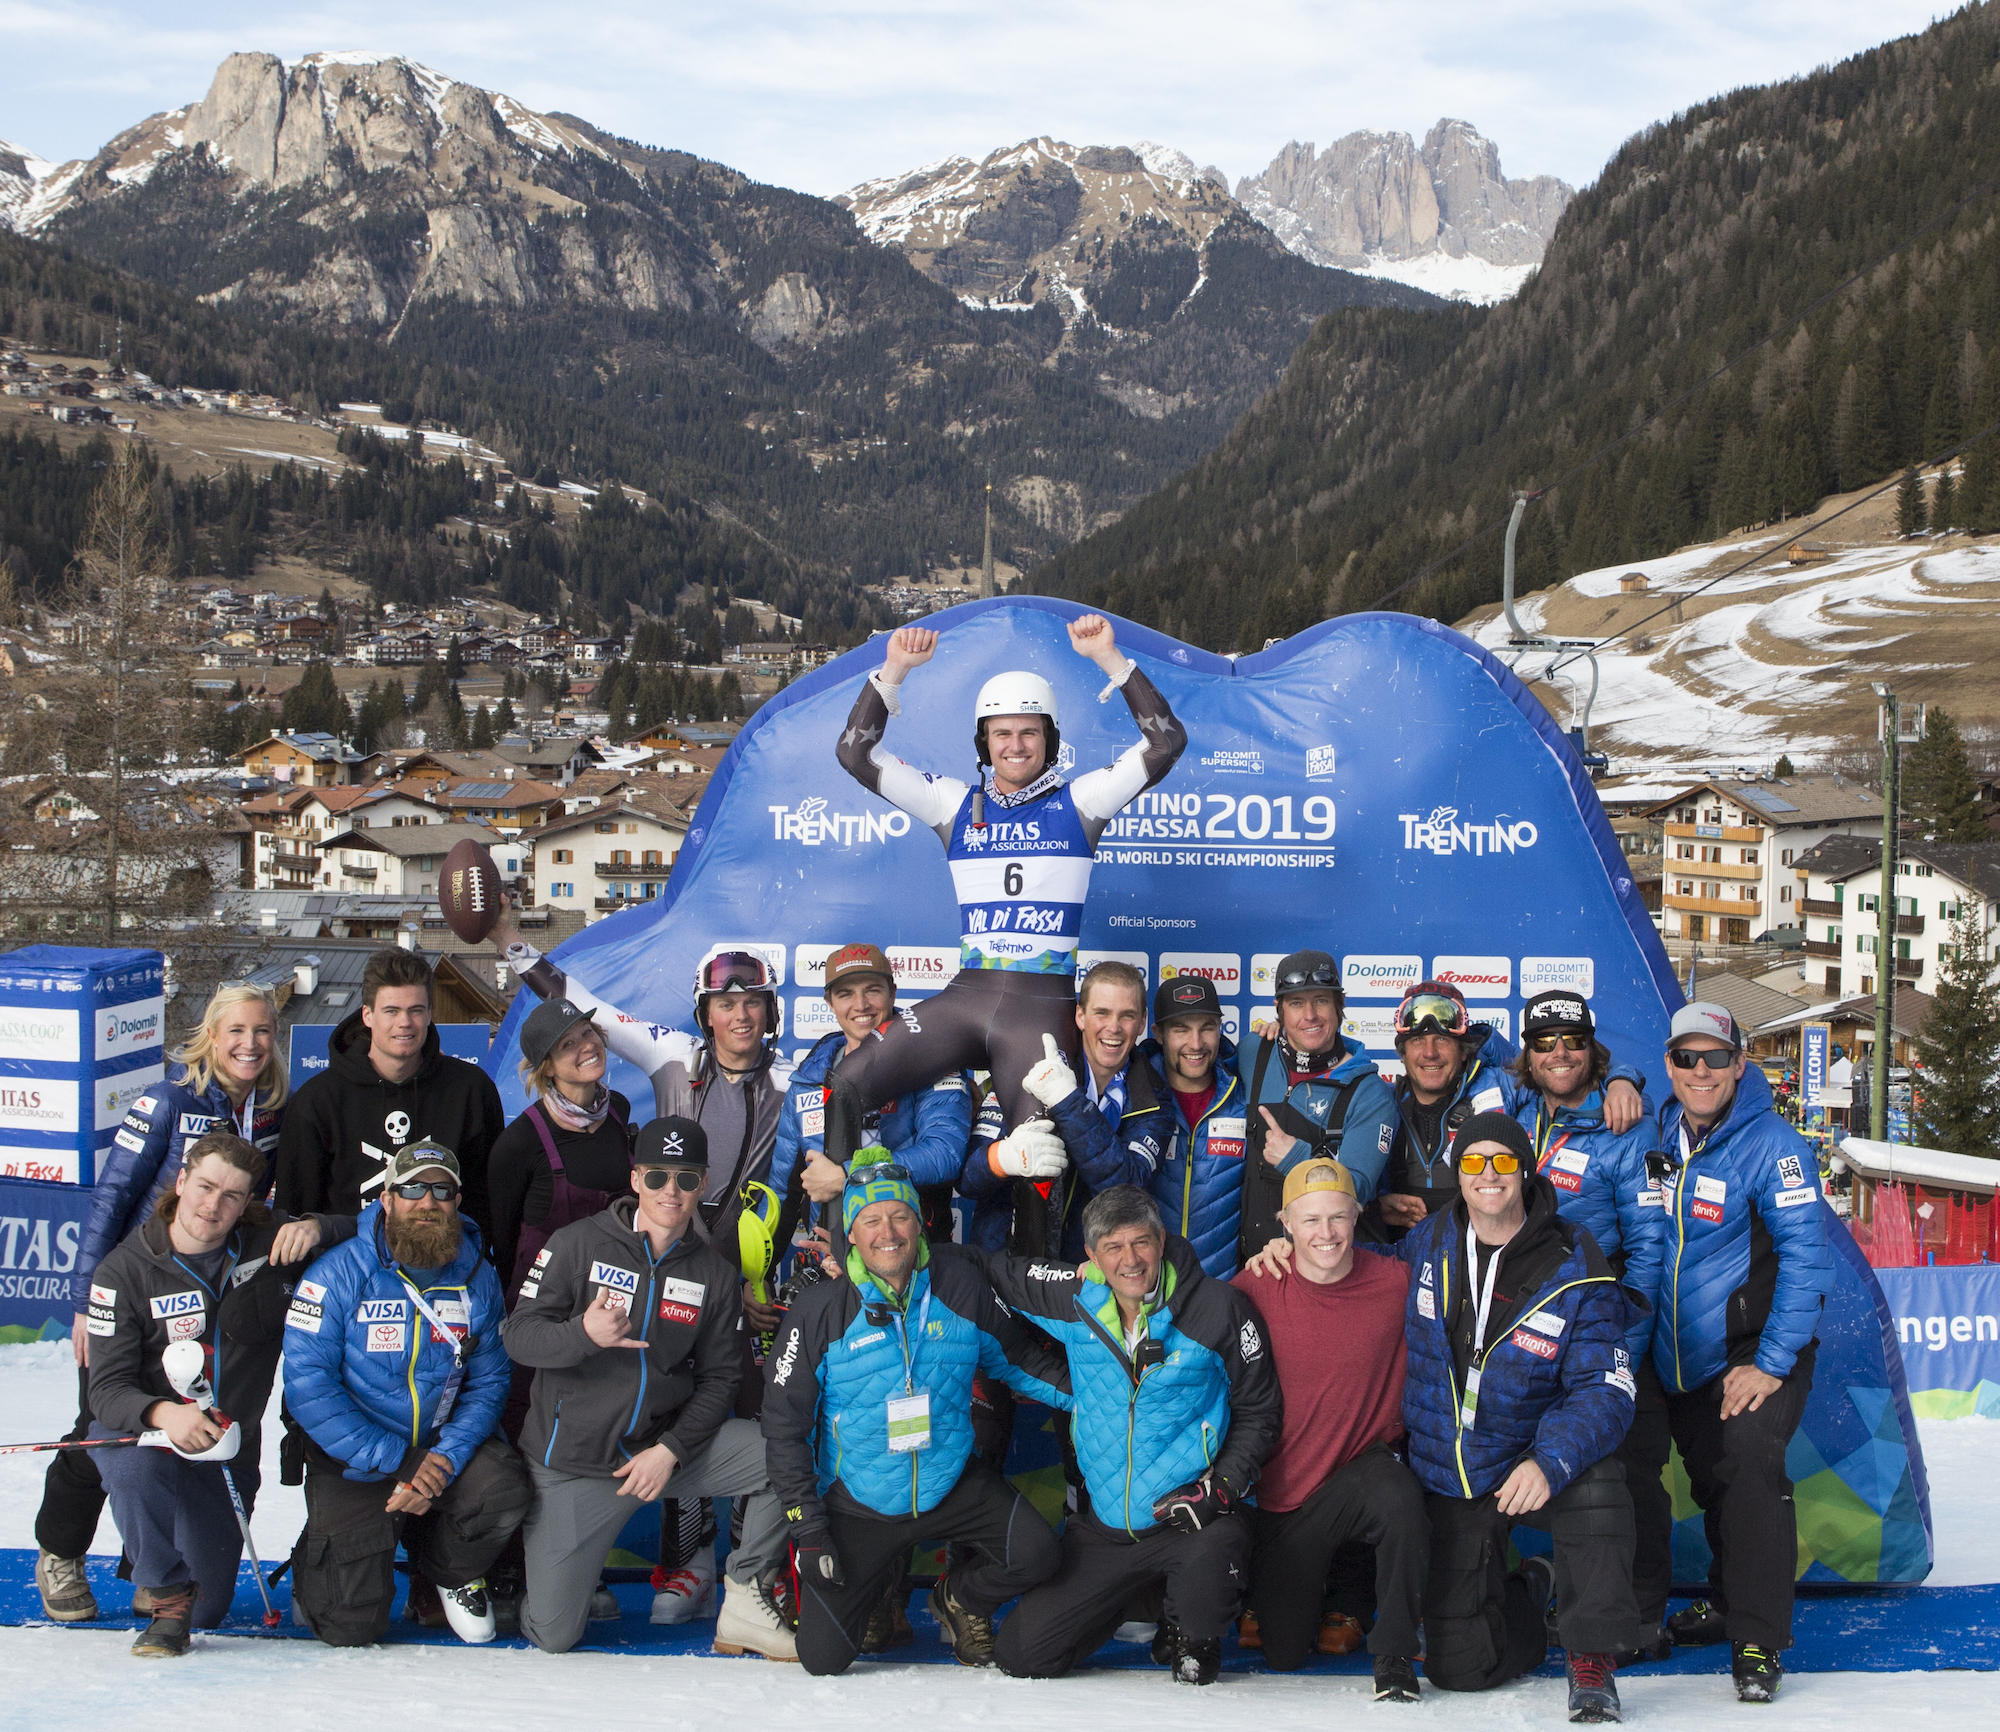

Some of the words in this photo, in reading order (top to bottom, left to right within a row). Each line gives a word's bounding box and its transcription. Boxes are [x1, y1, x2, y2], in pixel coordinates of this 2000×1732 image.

[1201, 757, 1248, 767] SUPERSKI
[1214, 751, 1260, 760] DOLOMITI
[1029, 774, 1056, 795] SHRED
[1205, 794, 1337, 841] 2019
[768, 805, 911, 846] TRENTINO
[990, 820, 1041, 842] ITAS
[1398, 814, 1538, 857] TRENTINO
[990, 840, 1069, 851] ASSICURAZIONI
[1117, 851, 1173, 865] WORLD
[1175, 852, 1201, 866] SKI
[1204, 853, 1336, 868] CHAMPIONSHIPS
[1003, 862, 1024, 896] 6
[968, 908, 988, 933] VAL
[1108, 916, 1145, 928] Official
[1147, 916, 1197, 929] Sponsors
[989, 939, 1033, 954] TRENTINO
[908, 957, 944, 972] ITAS
[1347, 963, 1418, 977] Dolomiti
[1537, 963, 1588, 973] DOLOMITI
[1178, 967, 1239, 981] CONAD
[1435, 971, 1509, 984] NORDICA
[1522, 974, 1575, 984] SUPERSKI
[1370, 978, 1414, 990] energia
[30, 1023, 64, 1040] COOP
[120, 1014, 158, 1035] Dolomiti
[133, 1028, 155, 1041] energia
[1807, 1034, 1823, 1107] WELCOME
[1, 1089, 41, 1108] ITAS
[1, 1107, 64, 1119] ASSICURAZIONI
[185, 1116, 211, 1132] VIS
[1211, 1141, 1241, 1155] xfinity
[1779, 1157, 1798, 1170] US
[1550, 1173, 1578, 1189] xfinity
[1784, 1193, 1808, 1201] BOSE
[1692, 1204, 1720, 1220] xfinity
[596, 1264, 635, 1291] VISA
[677, 1286, 702, 1297] SPYDER
[155, 1293, 201, 1314] VISA
[291, 1299, 322, 1317] USANA
[363, 1303, 404, 1318] VISA
[290, 1316, 311, 1325] BOSE
[663, 1305, 696, 1322] xfinity
[1534, 1316, 1562, 1329] SPYDER
[172, 1329, 203, 1341] TOYOTA
[1898, 1315, 1999, 1351] ngen
[1514, 1332, 1555, 1358] xfinity
[774, 1328, 799, 1387] TRENTINO
